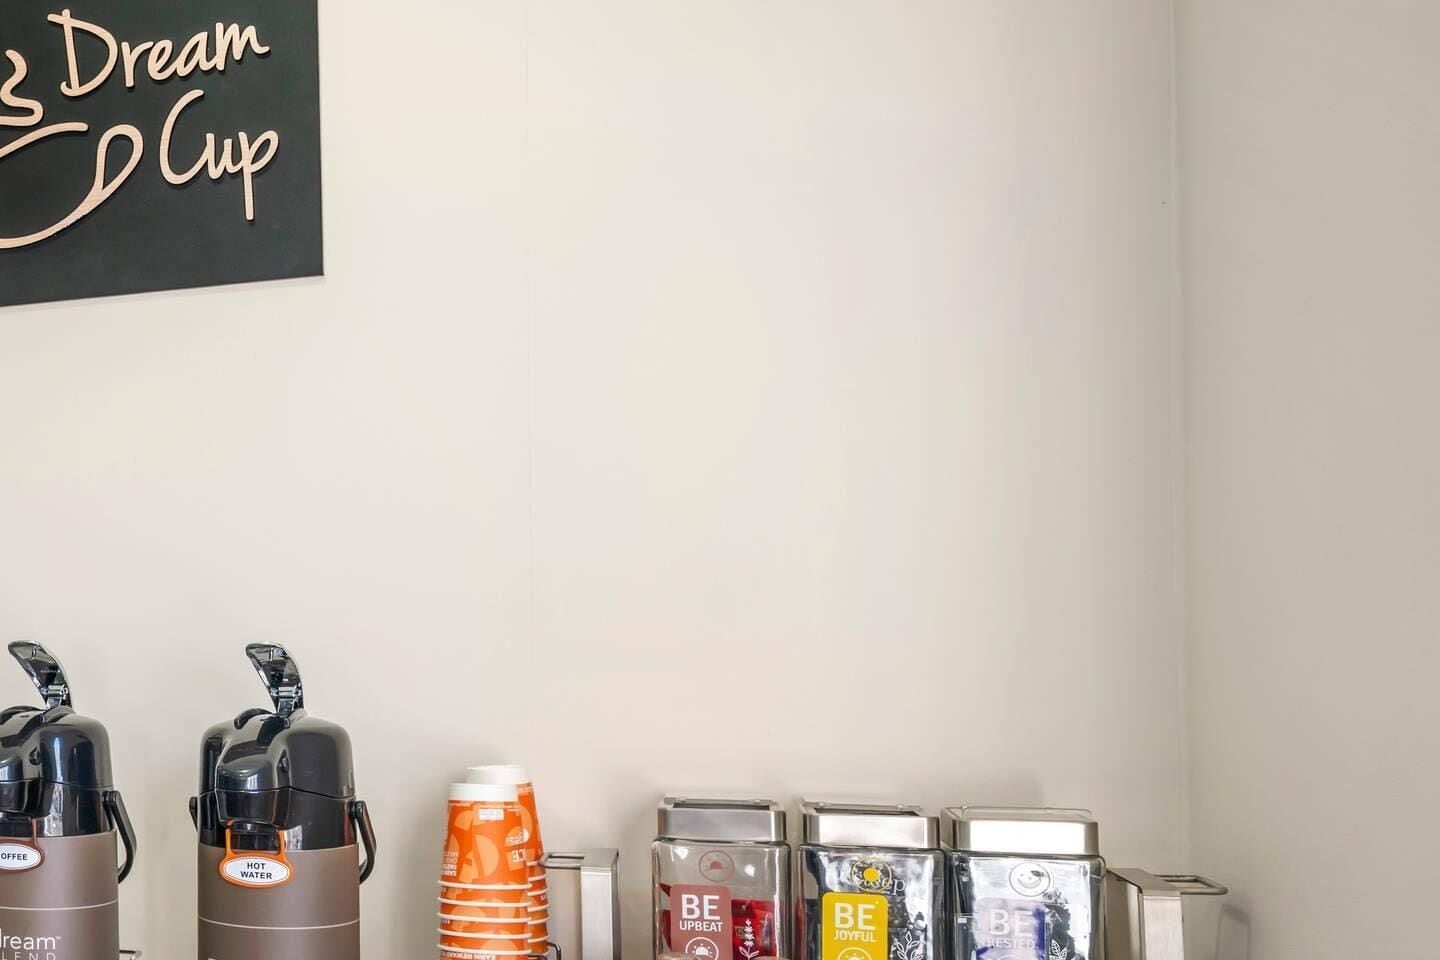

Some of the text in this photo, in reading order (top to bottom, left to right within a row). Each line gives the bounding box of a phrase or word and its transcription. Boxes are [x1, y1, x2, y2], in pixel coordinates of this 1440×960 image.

[47, 8, 270, 97] Dream
[160, 89, 279, 221] Cup
[240, 871, 273, 879] WATER
[246, 862, 266, 870] HOT
[681, 894, 720, 920] BE
[834, 902, 876, 931] BE
[679, 920, 723, 932] UPBEAT
[834, 930, 877, 942] JOYFUL
[990, 909, 1034, 937] BE
